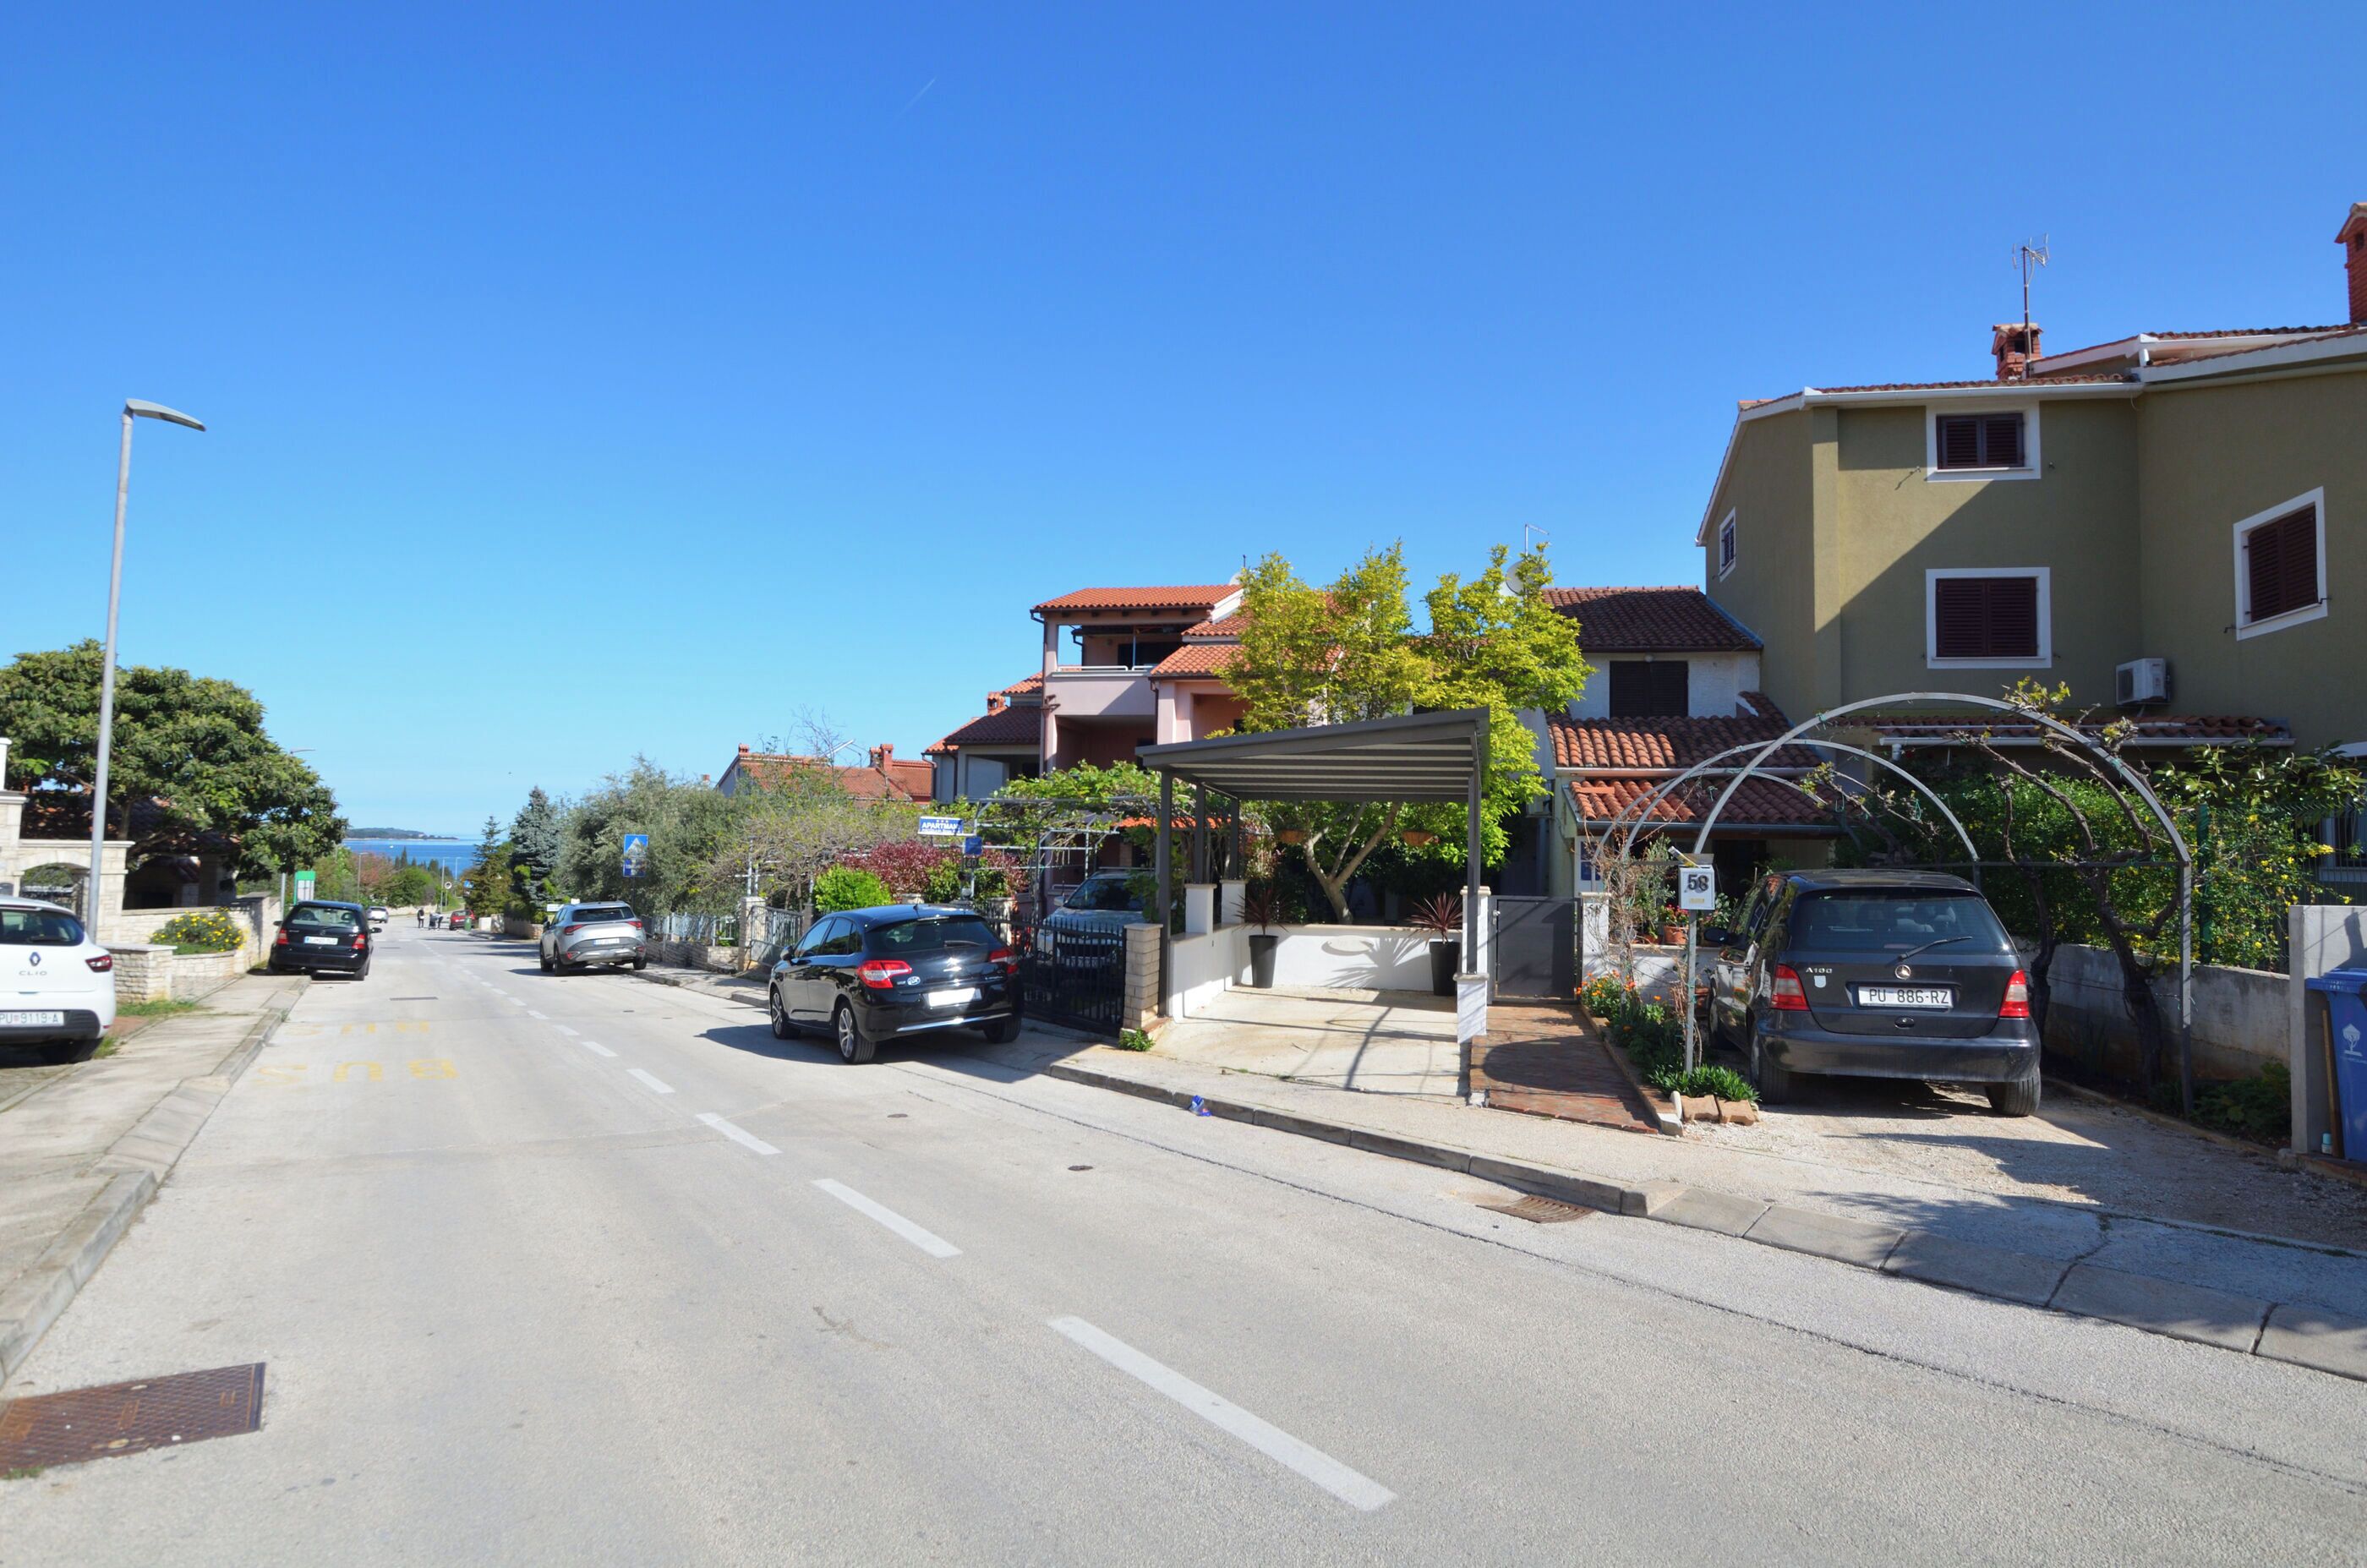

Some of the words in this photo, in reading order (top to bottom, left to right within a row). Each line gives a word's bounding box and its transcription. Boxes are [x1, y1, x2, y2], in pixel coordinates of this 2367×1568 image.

[966, 859, 977, 867] 60
[1687, 873, 1709, 892] 58
[1869, 989, 1886, 1003] PU
[1897, 989, 1949, 1004] 886-RZ
[0, 1013, 13, 1024] PU
[250, 1058, 460, 1090] BUS
